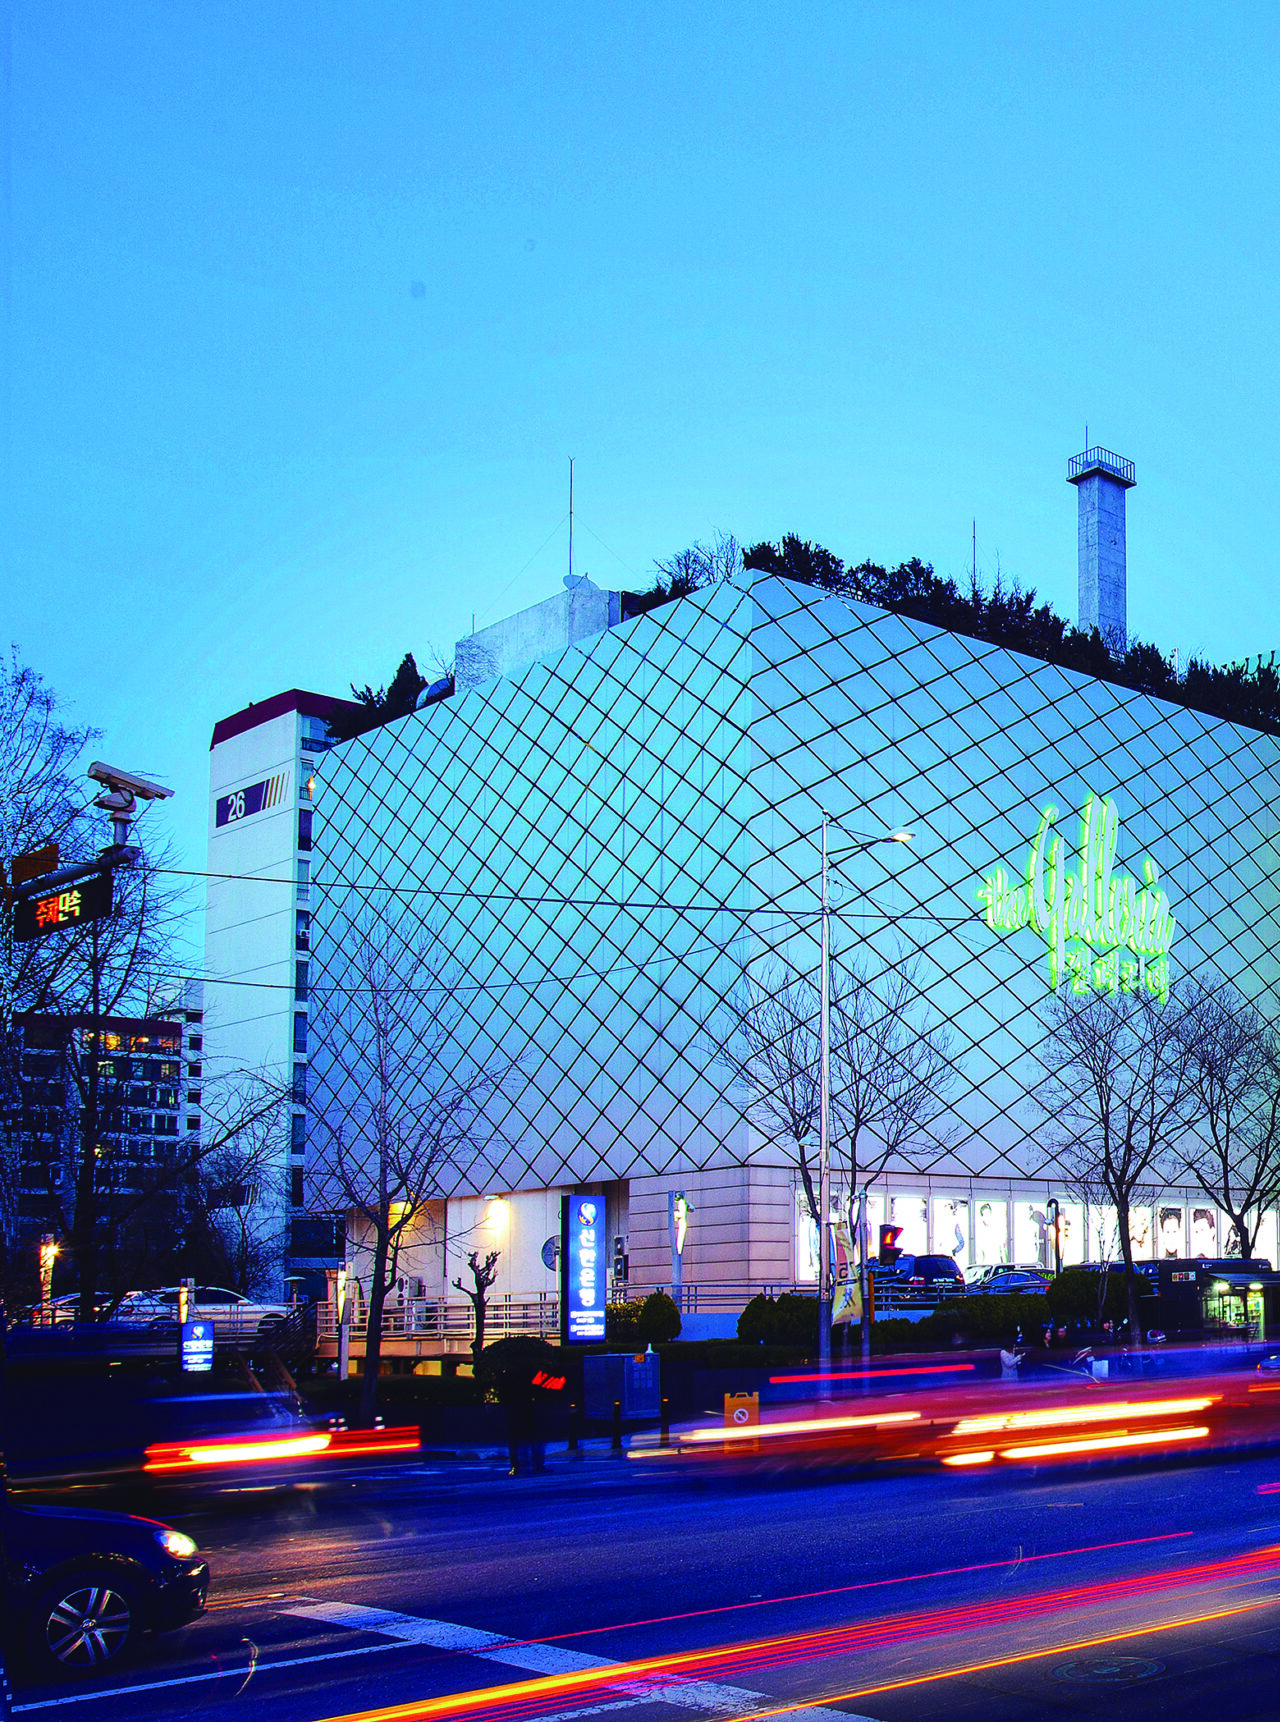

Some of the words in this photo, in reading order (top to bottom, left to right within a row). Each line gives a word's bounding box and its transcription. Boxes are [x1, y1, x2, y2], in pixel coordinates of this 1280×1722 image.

[227, 791, 246, 822] 26
[977, 867, 1030, 930] the
[1064, 947, 1169, 1005] 갤러리아
